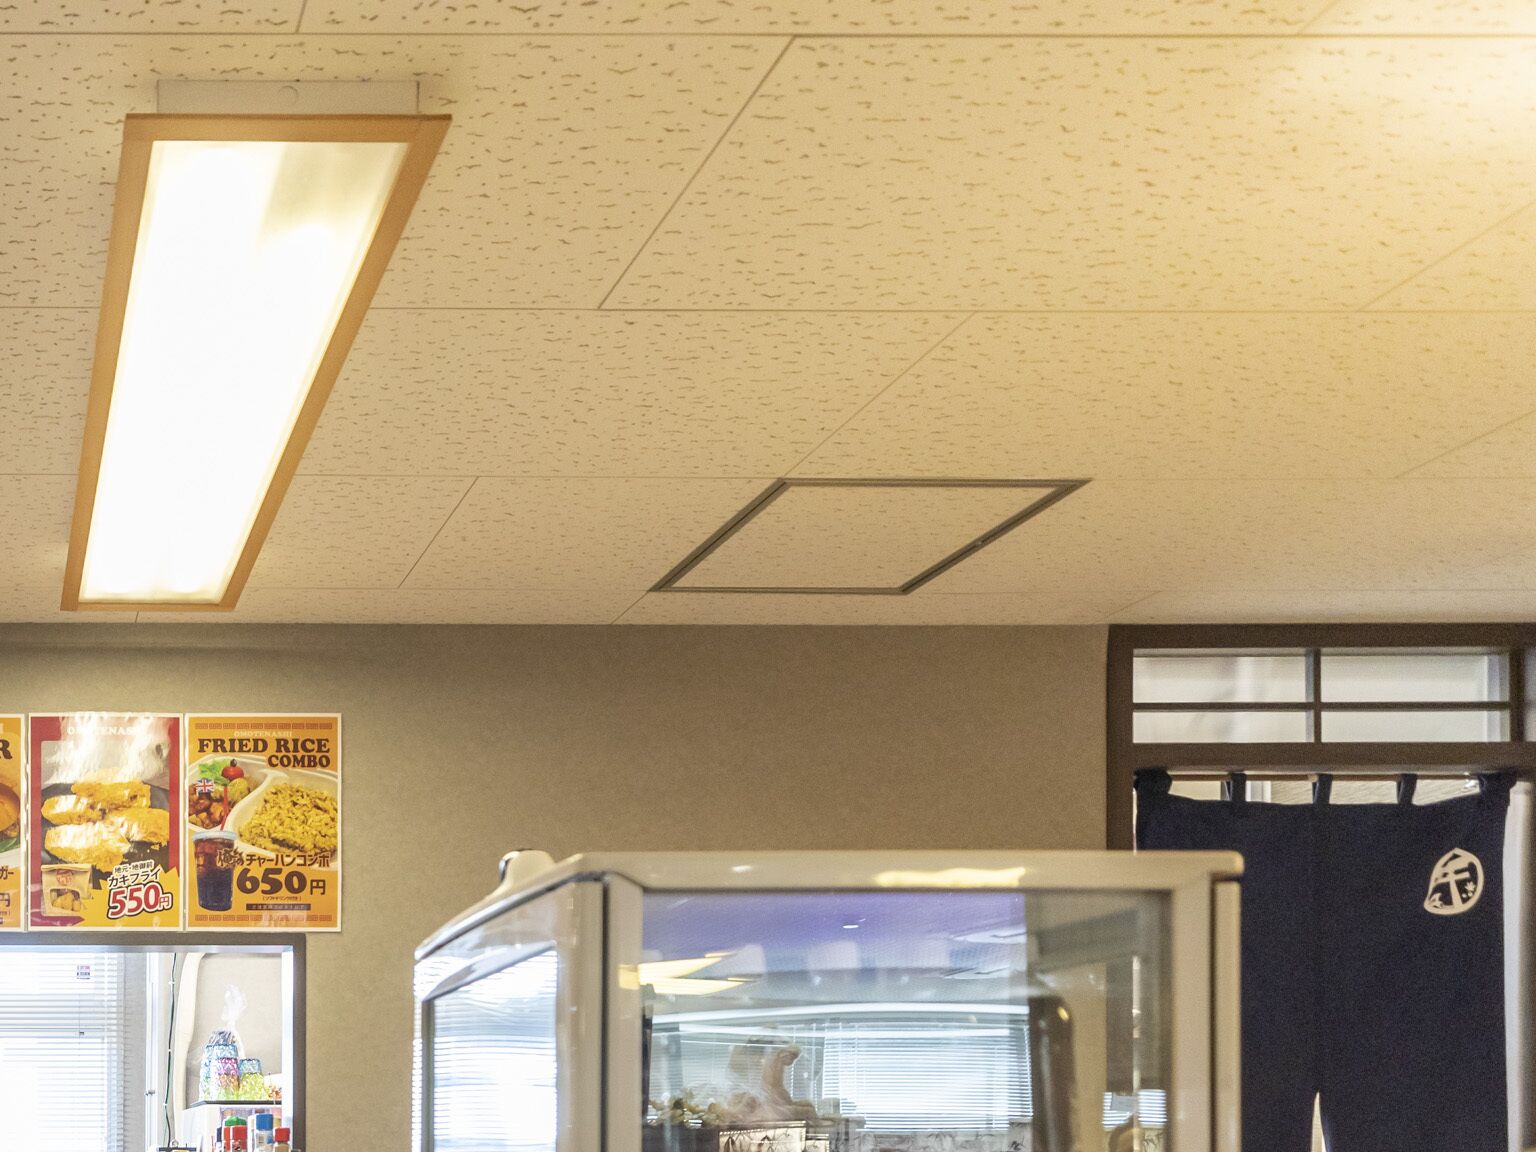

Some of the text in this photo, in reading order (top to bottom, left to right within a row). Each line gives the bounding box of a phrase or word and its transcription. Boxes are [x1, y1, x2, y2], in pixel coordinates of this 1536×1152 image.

[234, 730, 293, 738] OMOTENASHI
[197, 738, 330, 753] FRIED RICE
[267, 754, 331, 768] COMBO
[246, 854, 330, 868] チャーハンコンボ
[108, 869, 161, 888] カキフライ
[236, 867, 326, 896] 650円
[107, 882, 173, 919] 550円
